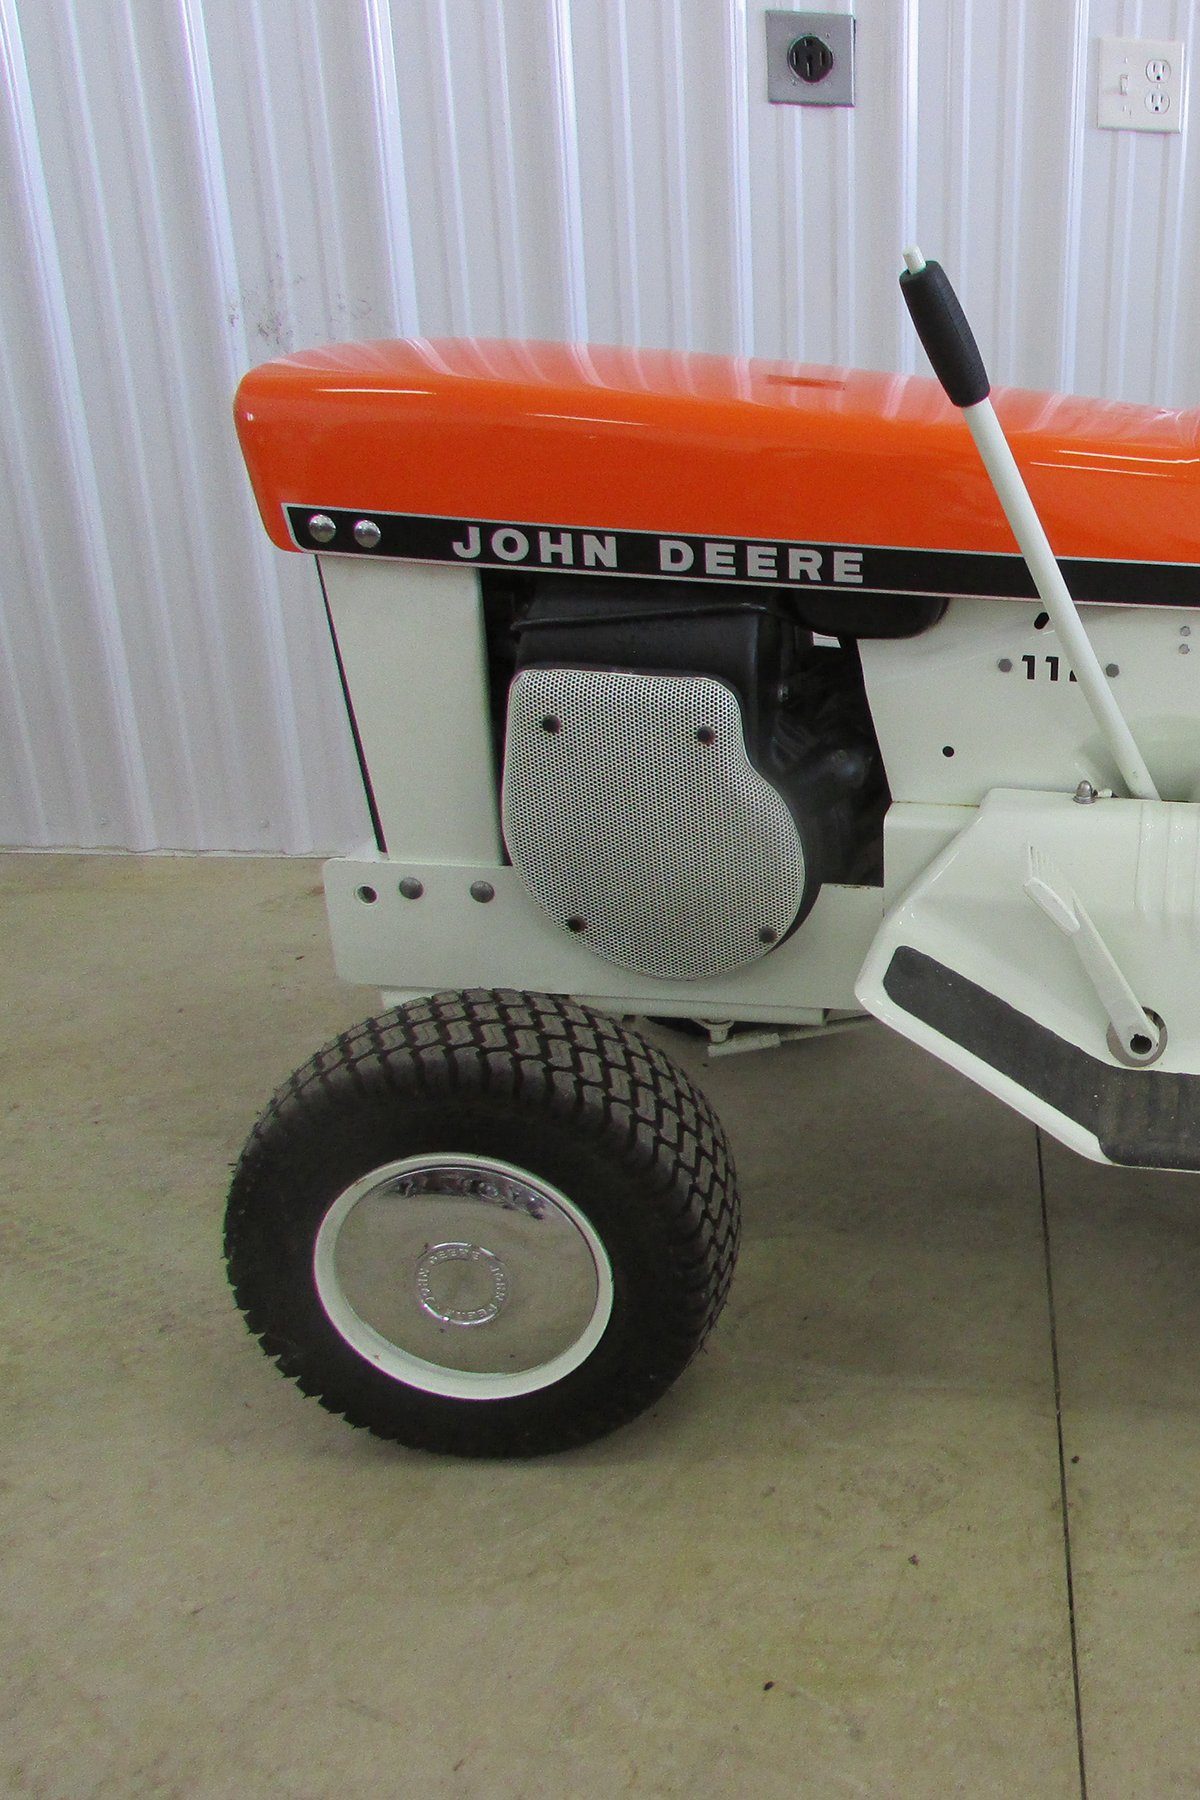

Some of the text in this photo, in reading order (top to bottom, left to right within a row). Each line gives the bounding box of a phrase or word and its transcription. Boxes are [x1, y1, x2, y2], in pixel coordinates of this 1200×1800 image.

[452, 526, 864, 584] JOHN DEERE
[1021, 655, 1078, 682] 11
